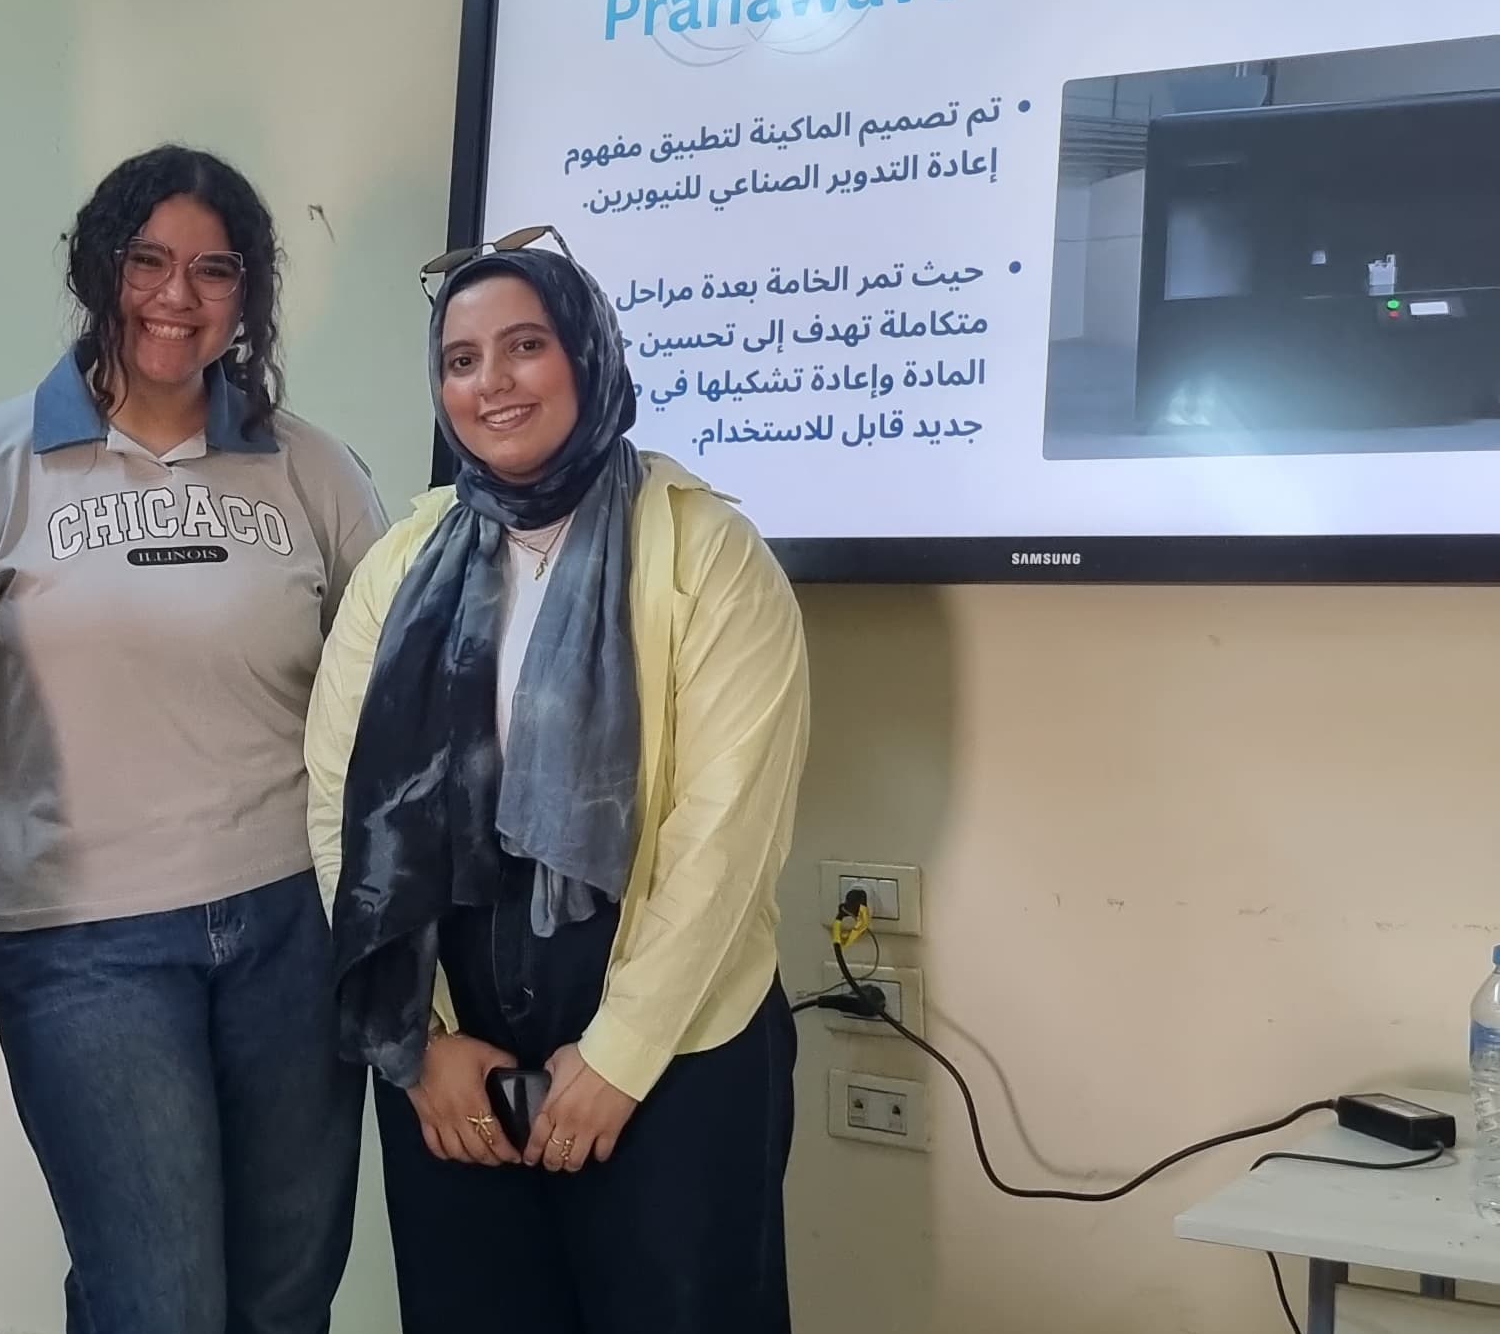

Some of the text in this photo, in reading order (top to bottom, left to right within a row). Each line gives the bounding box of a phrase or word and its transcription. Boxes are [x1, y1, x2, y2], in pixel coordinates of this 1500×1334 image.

[564, 97, 1002, 175] تم تصميم الماكينة لتطبيق مفهوم
[583, 147, 997, 214] إعادة التدوير الصناعي للنيوبرين.
[616, 261, 983, 311] حيث تمر الخامة بعدة مراحل
[640, 323, 736, 358] تحسين
[743, 319, 784, 354] إلى
[792, 314, 872, 347] تهدف
[880, 309, 988, 338] متكاملة
[697, 367, 803, 402] تشكيلها
[811, 363, 894, 399] وإعادة
[903, 358, 985, 387] المادة
[650, 369, 688, 412] في
[691, 409, 982, 456] جديد قابل للاستخدام.
[138, 549, 218, 562] ILLINOIS
[1011, 552, 1081, 565] SAMSUNG
